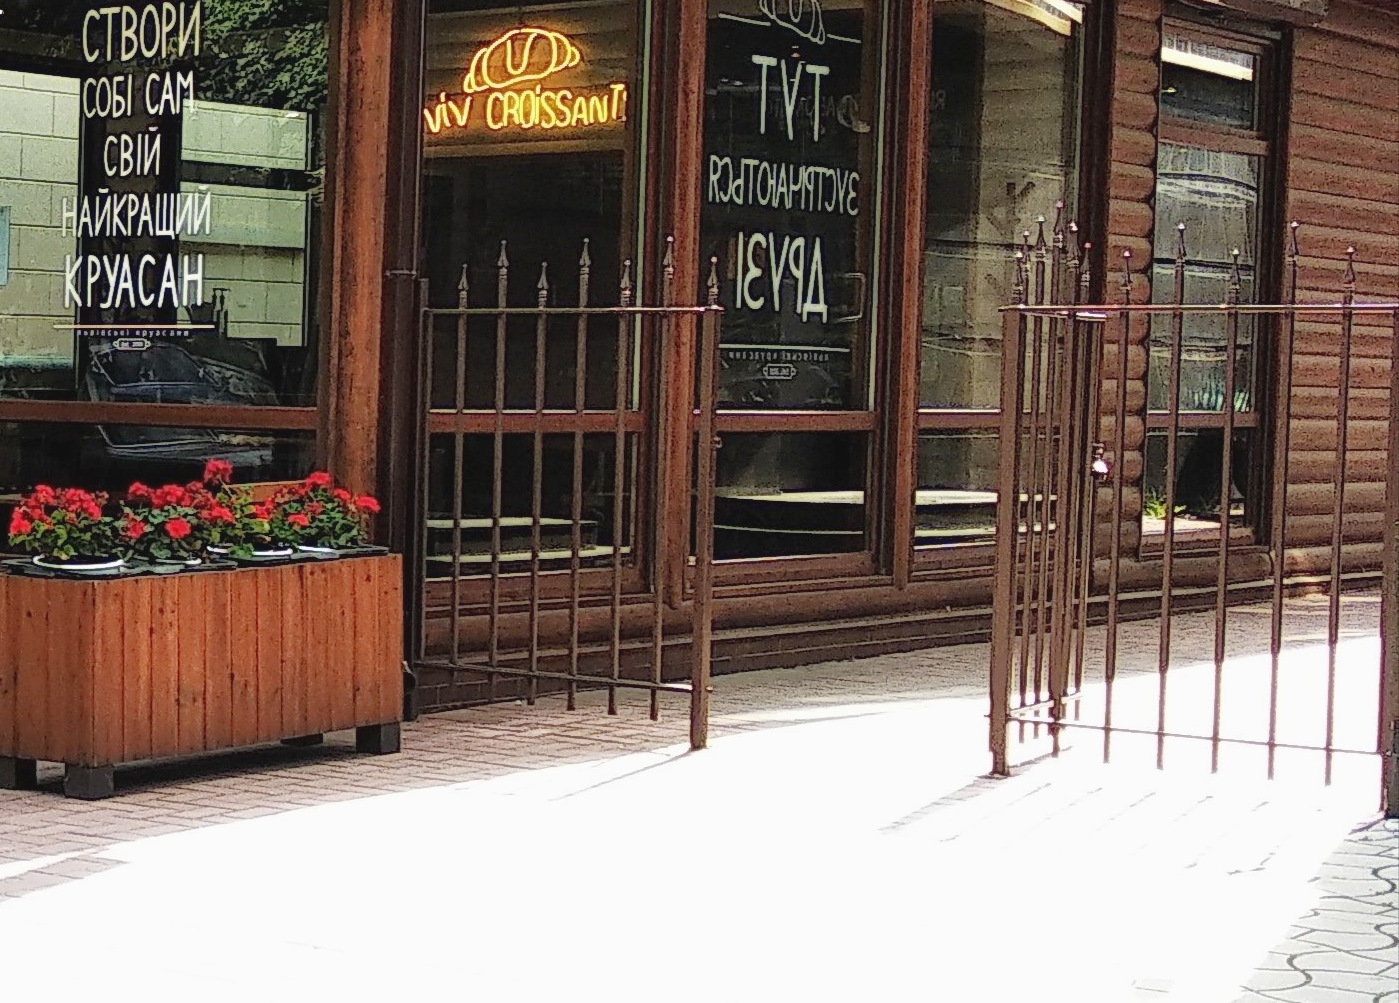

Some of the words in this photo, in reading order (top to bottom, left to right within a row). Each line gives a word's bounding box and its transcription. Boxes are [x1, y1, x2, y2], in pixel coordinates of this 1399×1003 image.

[82, 0, 202, 63] СТВОРИ
[83, 75, 132, 118] СОБІ
[145, 70, 195, 116] САМ
[103, 126, 161, 178] СВІЙ
[60, 185, 212, 238] НАЙКРАЩИЙ
[64, 253, 204, 309] КРУАСАН
